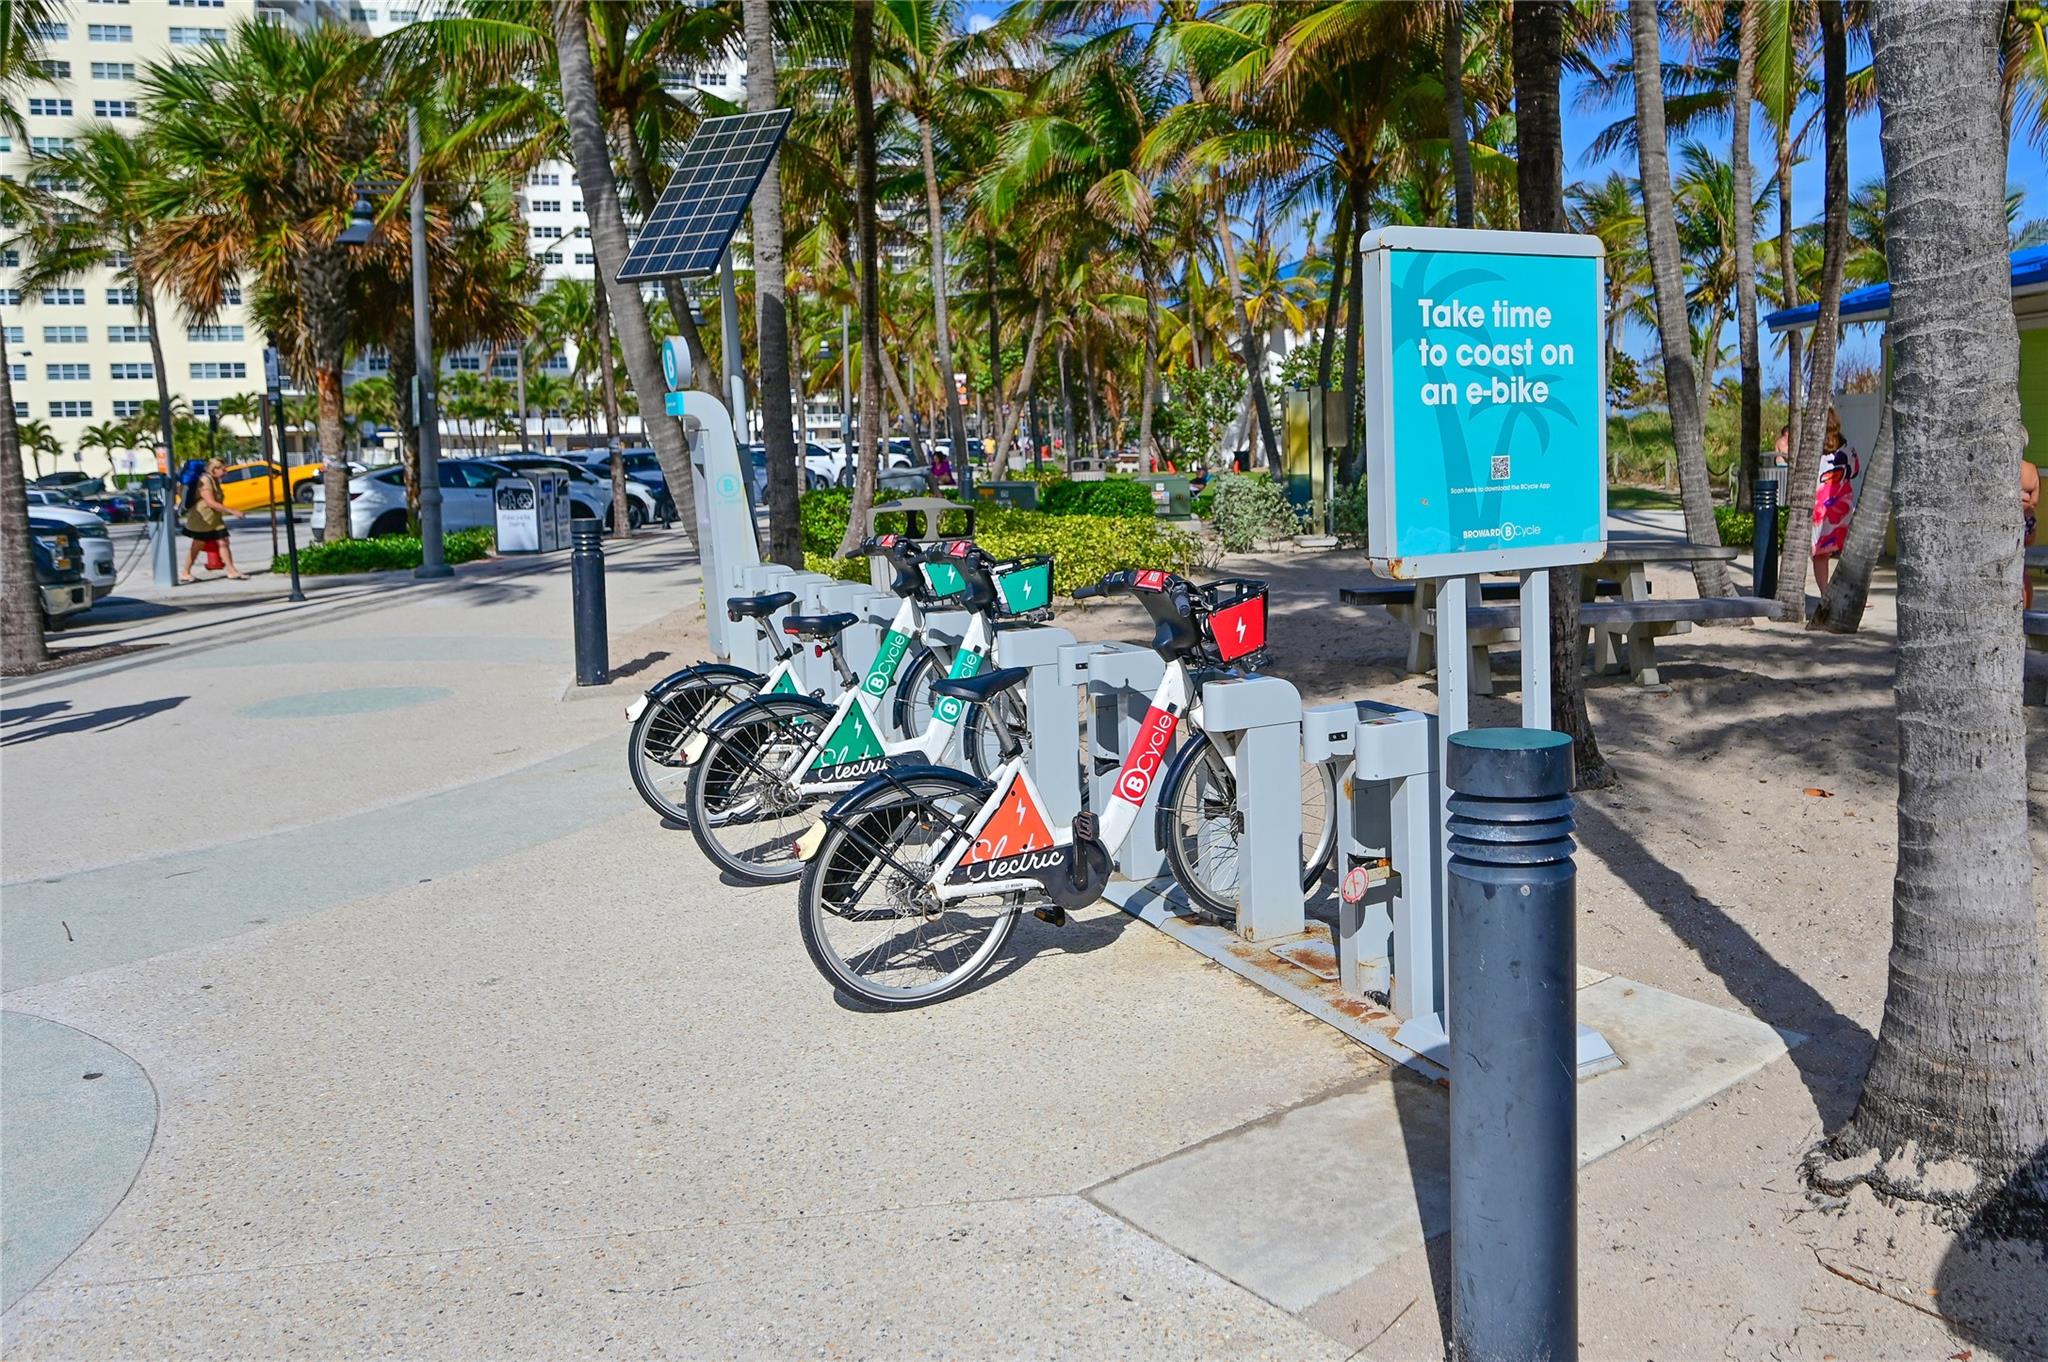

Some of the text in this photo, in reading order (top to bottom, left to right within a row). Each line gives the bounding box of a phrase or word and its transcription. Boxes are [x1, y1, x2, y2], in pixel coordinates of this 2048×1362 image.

[1418, 299, 1552, 328] Take time
[1419, 338, 1574, 367] to coast on
[1421, 376, 1549, 405] an e-bike
[1450, 487, 1464, 495] Scan
[1463, 528, 1500, 539] BROWARD
[967, 832, 1064, 881] Electric
